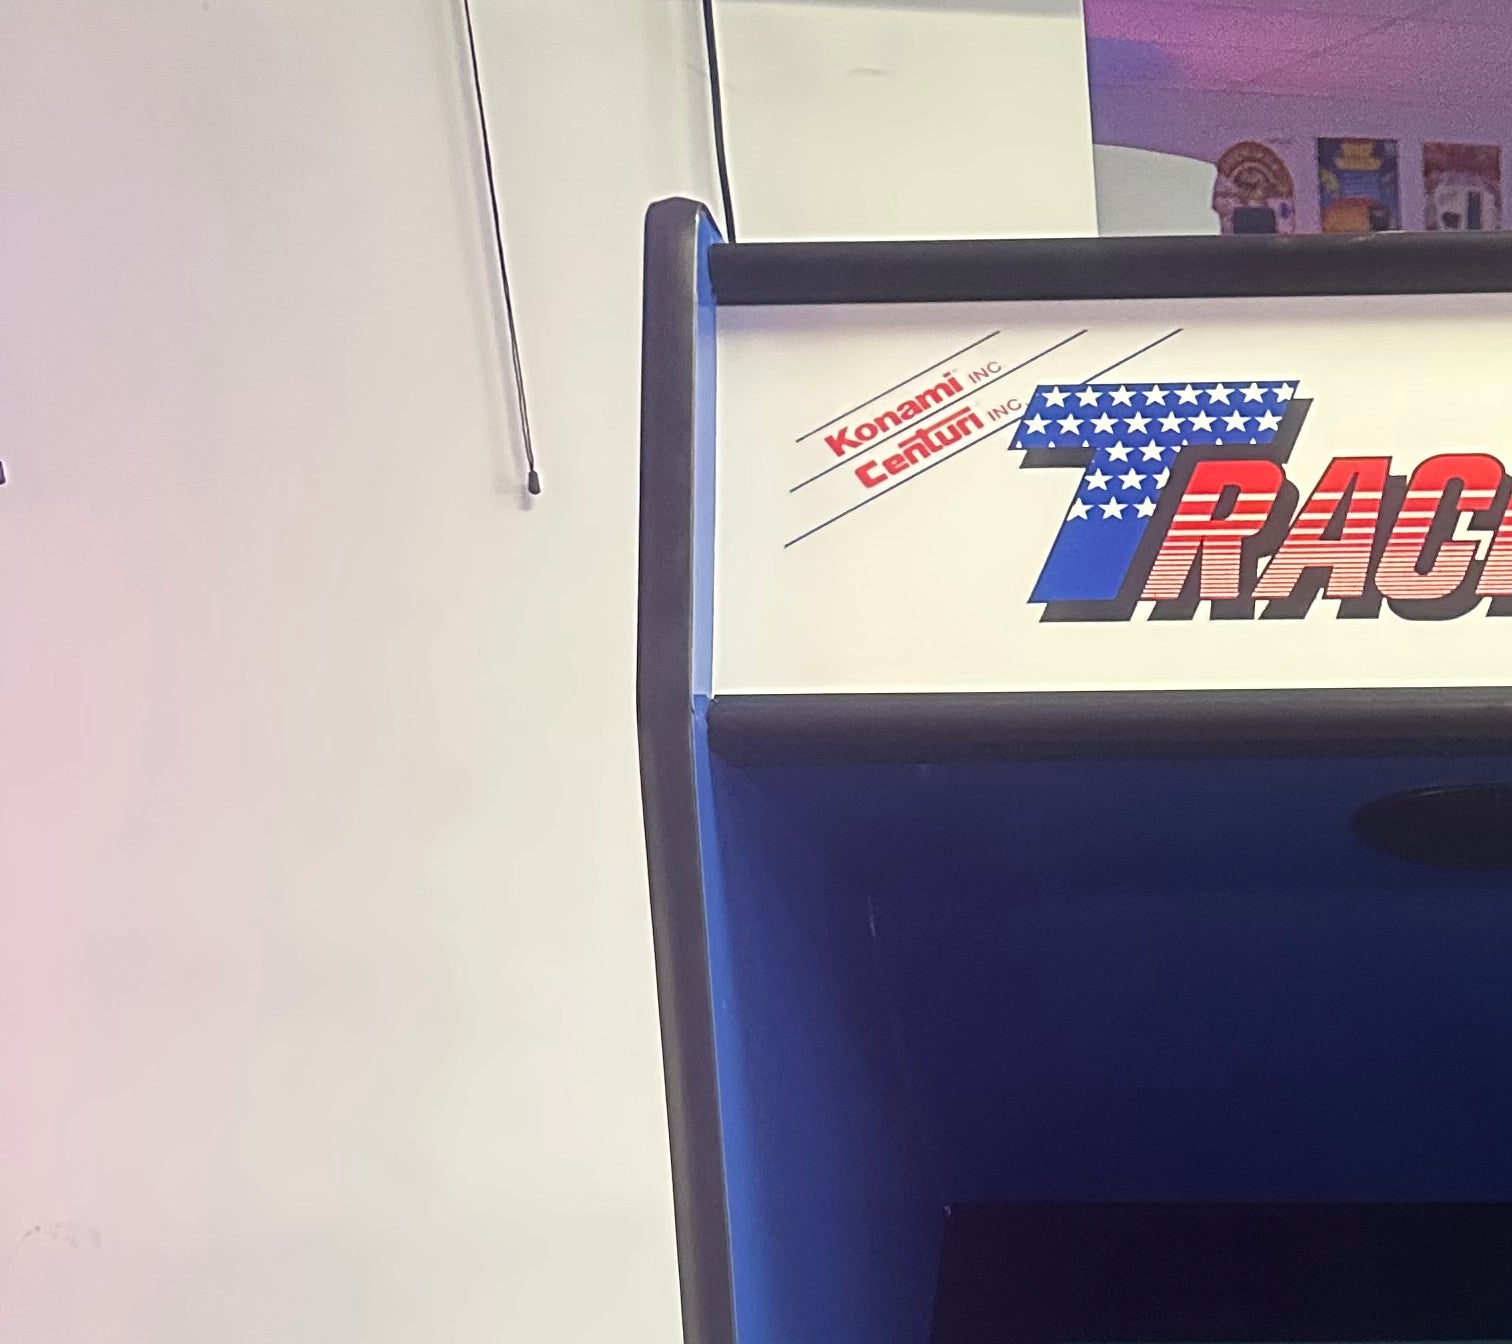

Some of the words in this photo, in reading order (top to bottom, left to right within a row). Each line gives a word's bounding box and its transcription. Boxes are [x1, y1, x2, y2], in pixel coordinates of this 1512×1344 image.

[824, 371, 964, 458] Konami
[968, 360, 1002, 384] INC
[987, 397, 1023, 422] INC
